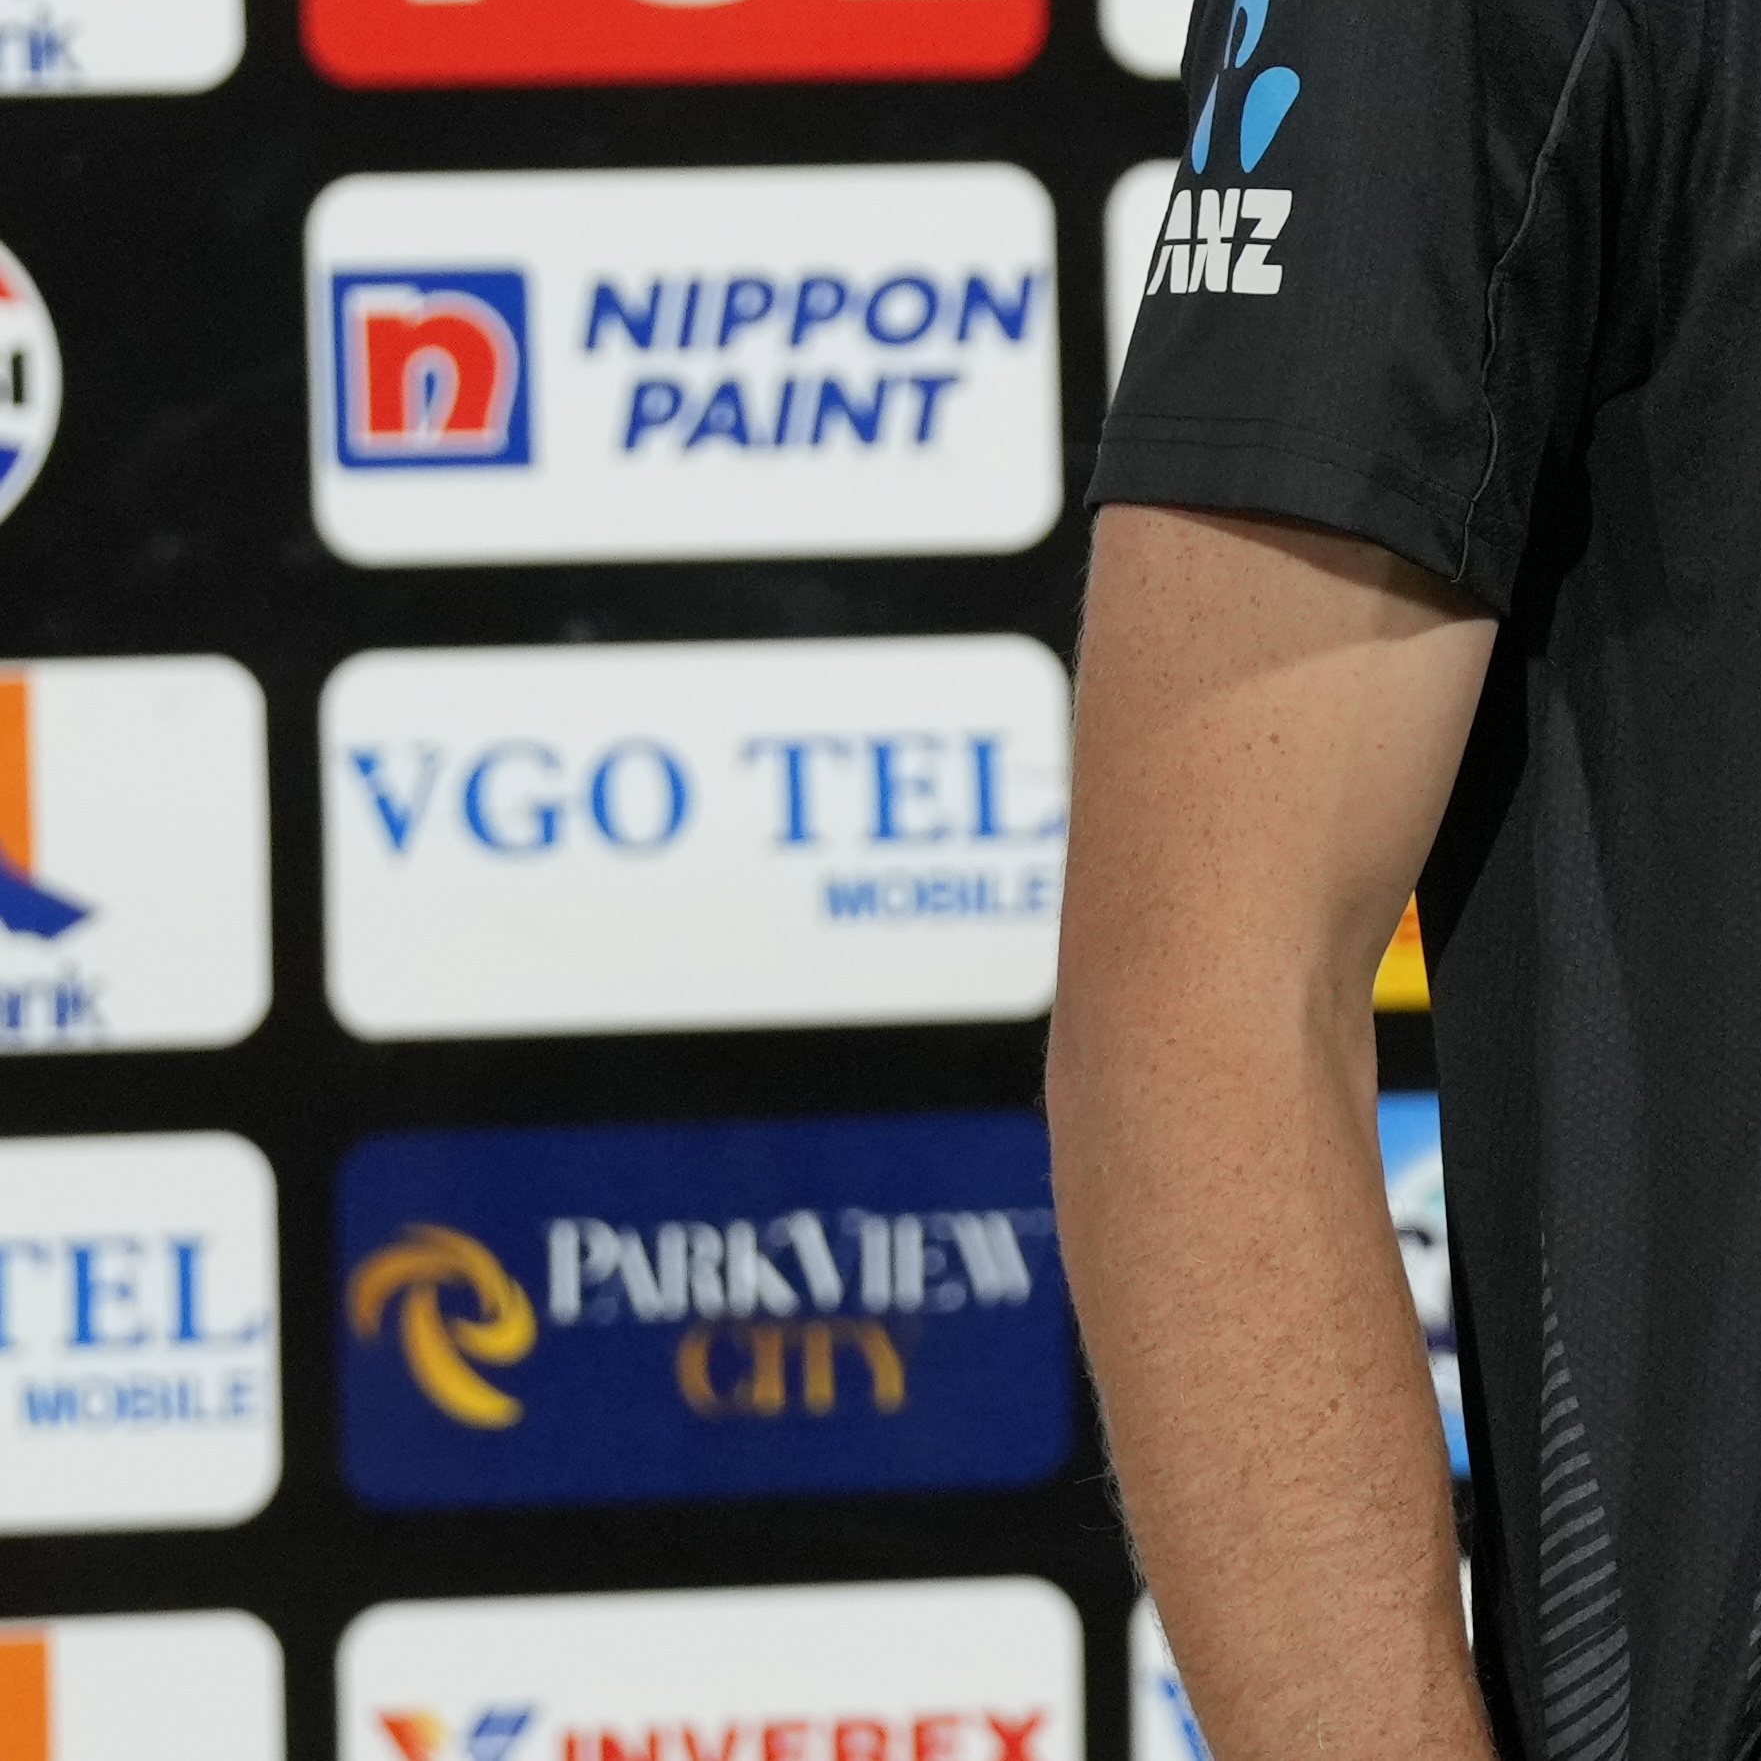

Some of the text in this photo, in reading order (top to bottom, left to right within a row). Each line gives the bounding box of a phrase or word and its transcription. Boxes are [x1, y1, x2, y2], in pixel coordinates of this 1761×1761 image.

[1146, 188, 1294, 296] ANZ
[583, 272, 1040, 351] NIPPON
[622, 375, 961, 454] PAINT
[346, 727, 1066, 858] VGO TEL
[824, 873, 1053, 924] MOBILE
[25, 1378, 259, 1429] MOBILE
[676, 1318, 916, 1416] CITY
